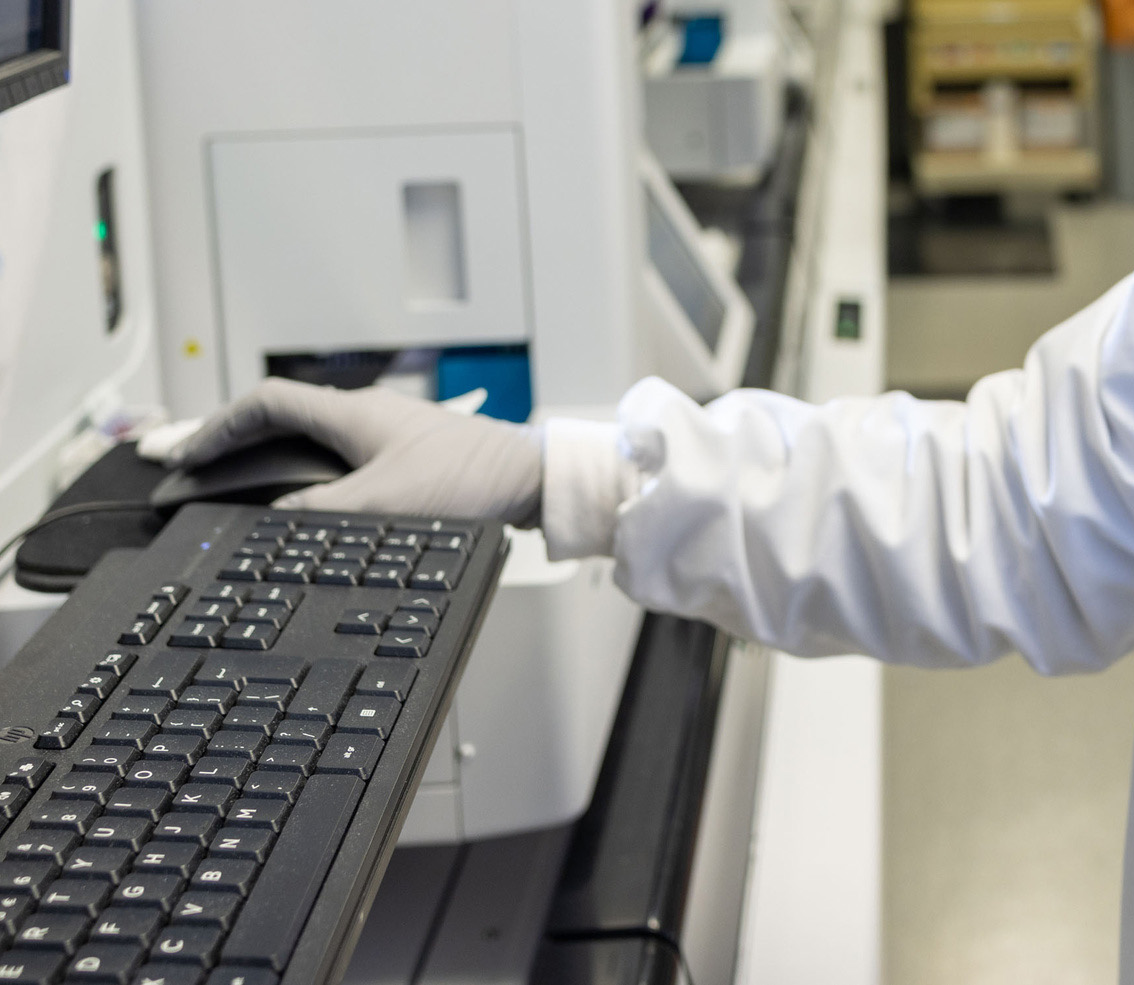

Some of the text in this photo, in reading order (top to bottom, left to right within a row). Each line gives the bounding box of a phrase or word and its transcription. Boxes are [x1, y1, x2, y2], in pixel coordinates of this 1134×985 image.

[135, 771, 152, 779] O
[181, 794, 201, 802] K
[236, 809, 256, 818] M
[96, 828, 114, 837] U
[219, 839, 240, 848] N
[71, 859, 92, 868] Y
[143, 854, 165, 863] H
[14, 876, 31, 884] 6
[201, 871, 221, 881] B
[123, 886, 144, 897] G
[47, 893, 70, 903] T
[181, 903, 202, 915] V
[99, 922, 120, 933] F
[22, 927, 48, 939] R
[161, 940, 183, 953] C
[76, 957, 100, 971] D
[0, 965, 23, 978] E
